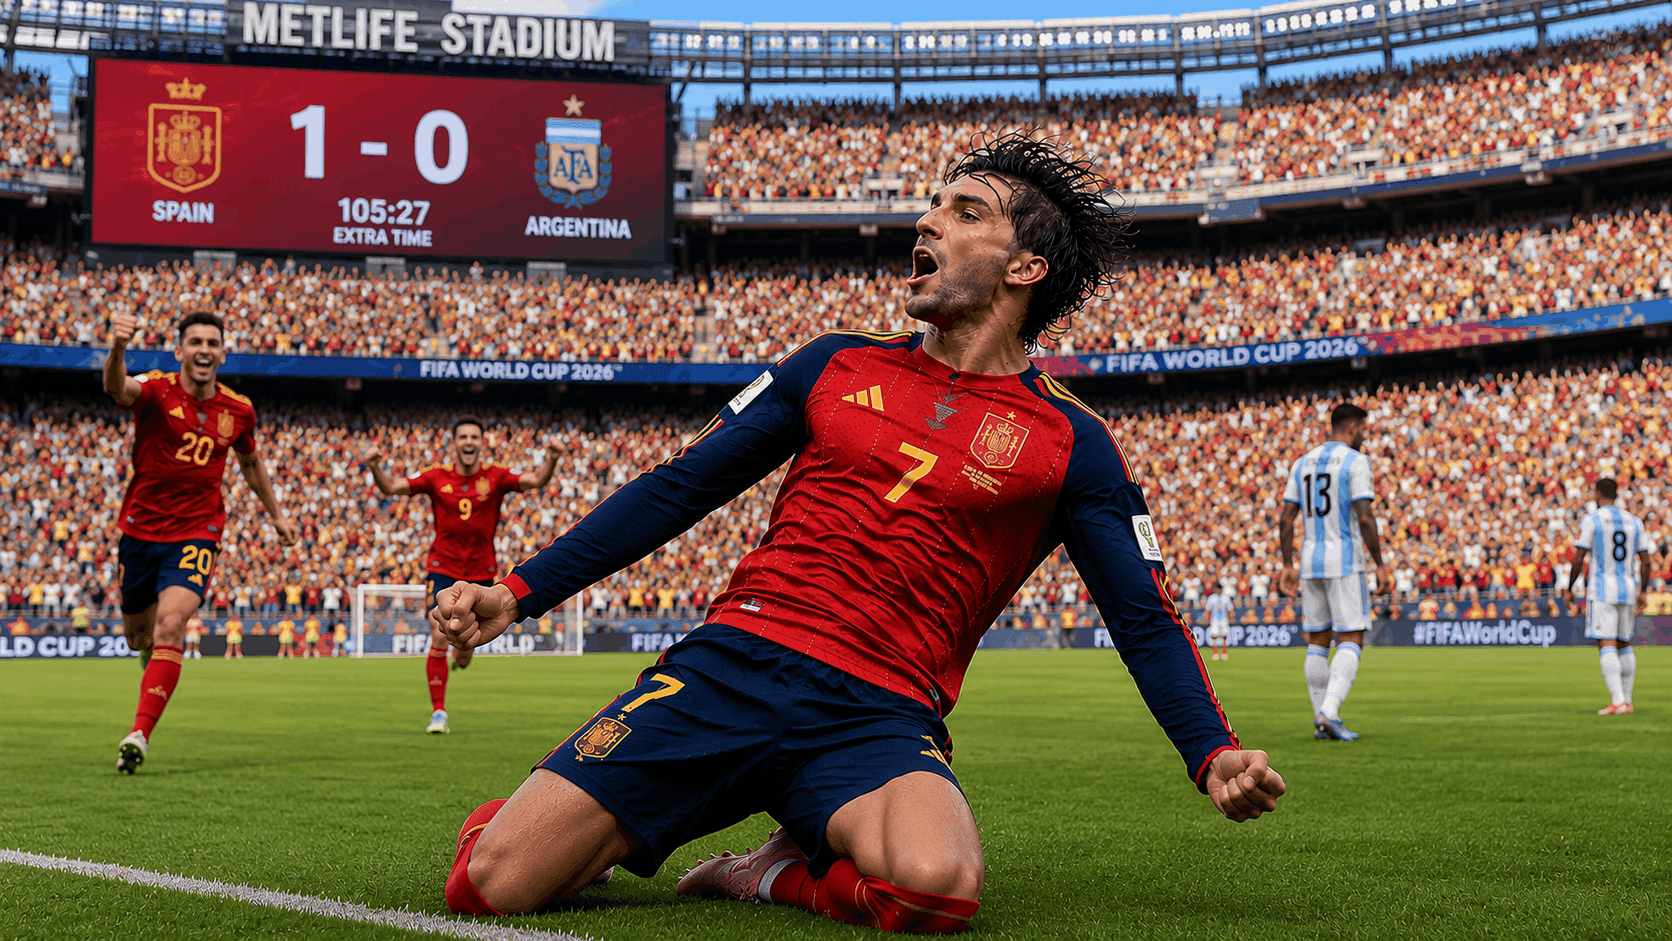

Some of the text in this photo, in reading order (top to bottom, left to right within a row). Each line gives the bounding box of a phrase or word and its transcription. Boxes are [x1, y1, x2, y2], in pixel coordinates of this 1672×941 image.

[242, 1, 615, 62] METLIFE STADIUM
[290, 104, 326, 179] 1
[414, 109, 469, 184] 0
[553, 145, 594, 184] AFA
[152, 200, 215, 224] SPAIN
[338, 197, 431, 226] 105:27
[524, 215, 632, 239] ARGENTINA
[333, 226, 432, 247] EXTRA TIME
[1106, 336, 1359, 373] FIFA WORLD CUP 2026
[420, 360, 615, 381] FIFA WORLD CUP 2026
[175, 432, 215, 466] 20
[884, 441, 939, 503] 7
[458, 498, 472, 521] 9
[1304, 473, 1331, 517] 13
[178, 545, 212, 576] 20
[1613, 530, 1627, 562] 8
[38, 636, 96, 657] CUP
[1413, 619, 1557, 648] #FIFAWorldCup
[621, 673, 685, 712] 7
